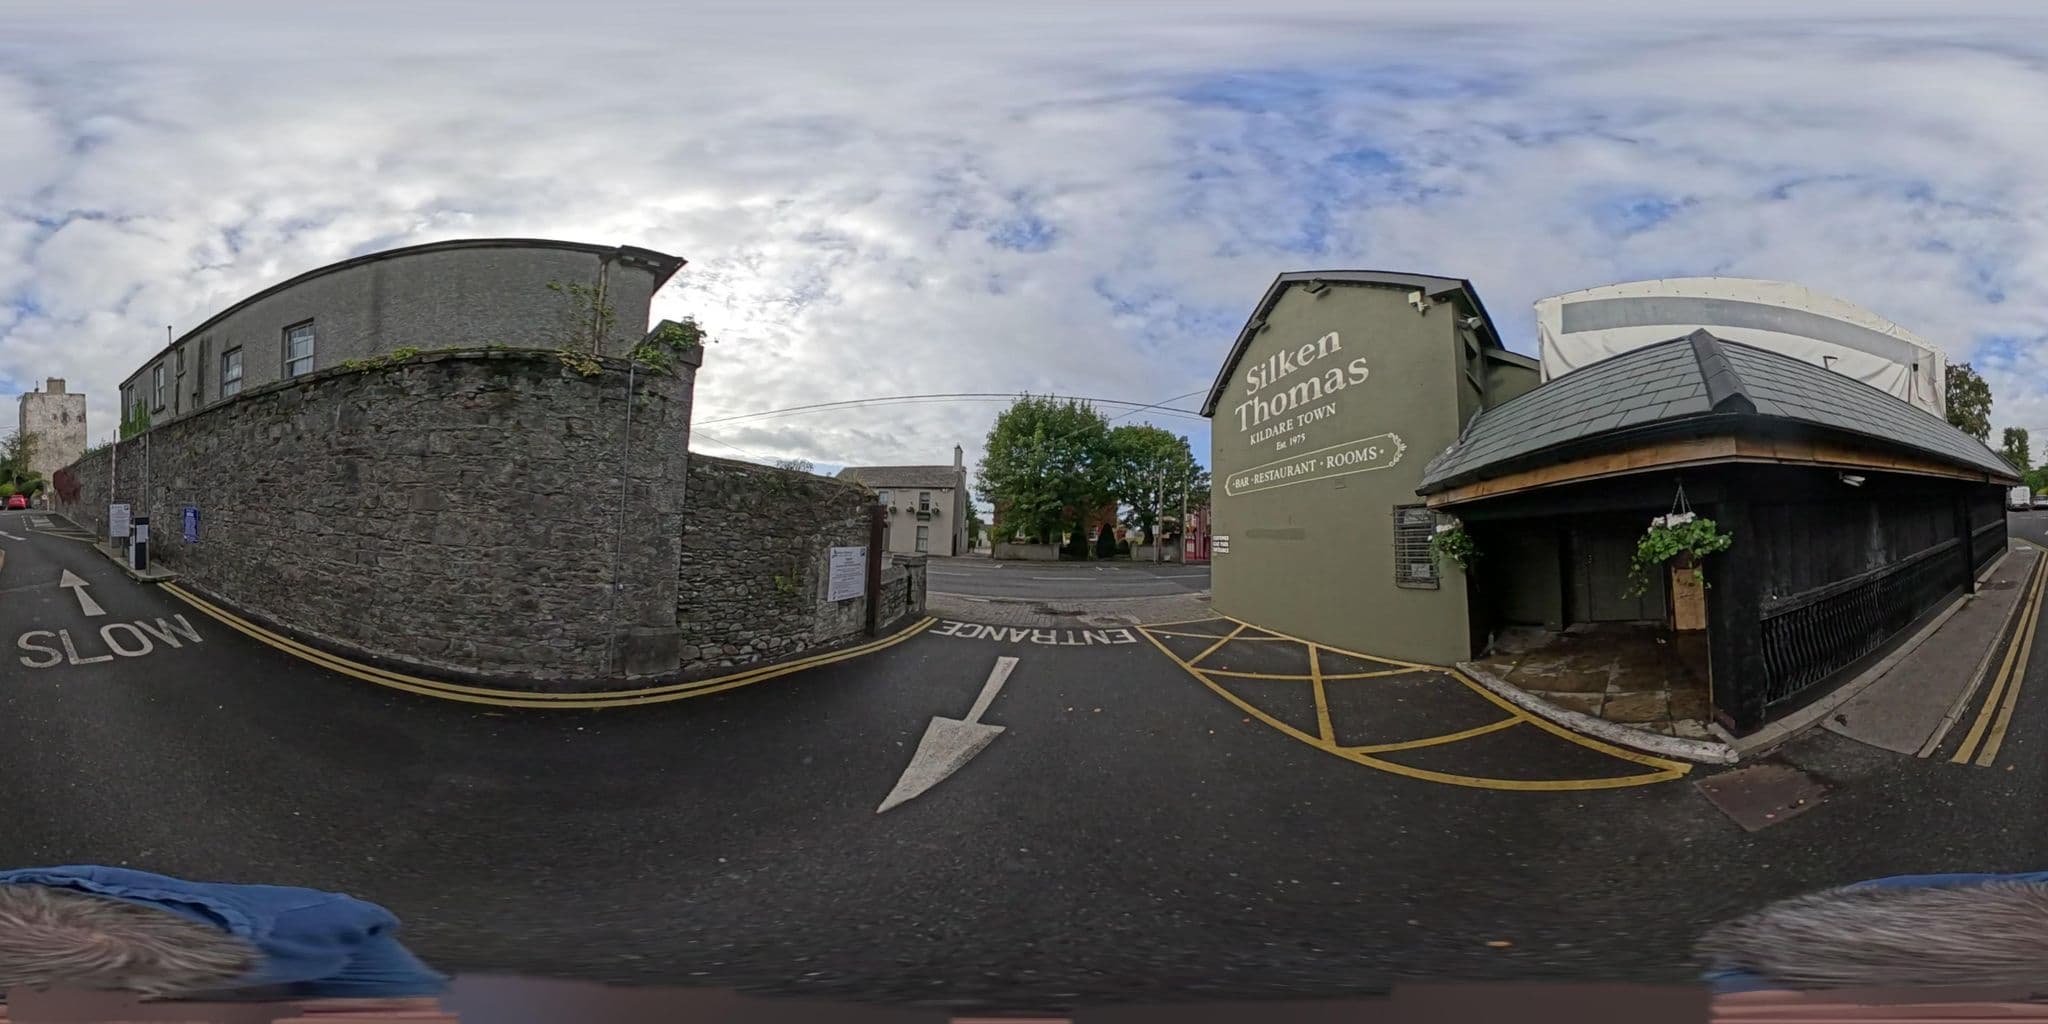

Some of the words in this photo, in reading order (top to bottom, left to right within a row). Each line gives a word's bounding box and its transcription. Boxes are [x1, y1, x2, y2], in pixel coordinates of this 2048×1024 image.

[1246, 331, 1342, 396] Silken
[1234, 357, 1369, 432] Thomas
[1250, 418, 1294, 446] KILDARE
[1296, 402, 1336, 427] TOWN
[1289, 432, 1306, 446] 1975
[1235, 476, 1250, 489] BAR
[1253, 459, 1317, 484] RESTAURANT
[1326, 446, 1378, 469] ROOMS
[17, 613, 203, 668] SLOW
[929, 619, 1138, 646] ENTRANCE
